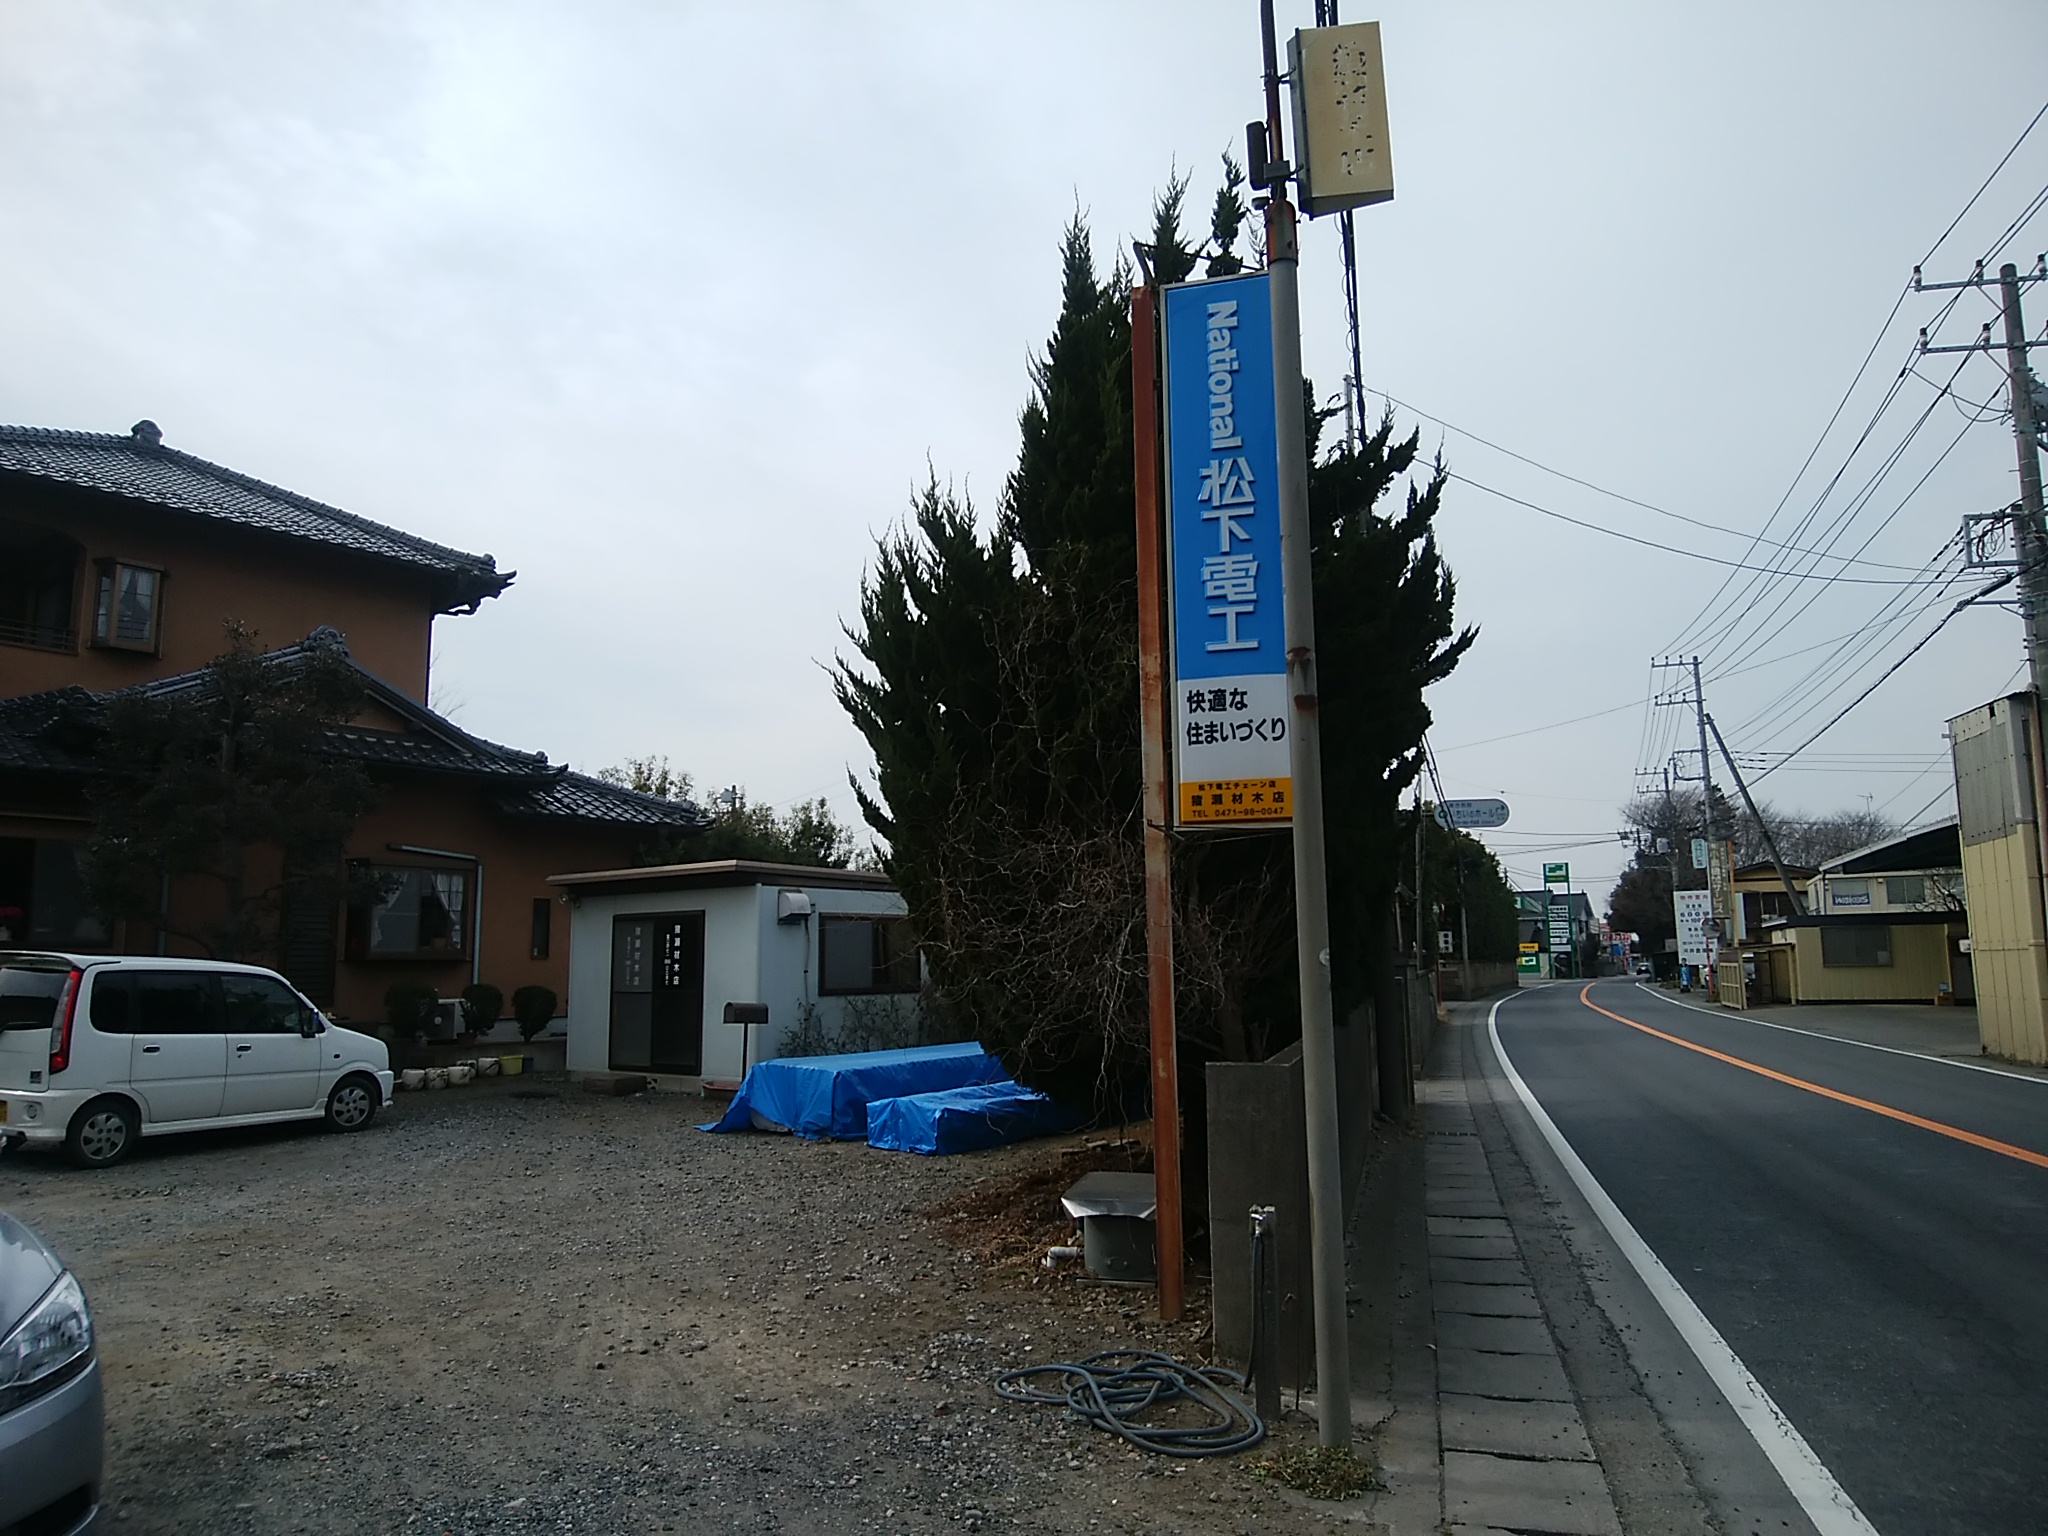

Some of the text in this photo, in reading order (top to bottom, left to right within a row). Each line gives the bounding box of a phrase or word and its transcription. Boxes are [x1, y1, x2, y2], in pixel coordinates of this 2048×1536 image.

[1198, 300, 1260, 652] National 松下電工
[1187, 687, 1248, 714] 快適な
[1187, 717, 1286, 746] 住まいづくり
[1198, 780, 1276, 791] 松下電工チェーン店
[1192, 807, 1284, 818] TEL 0471-98-0047
